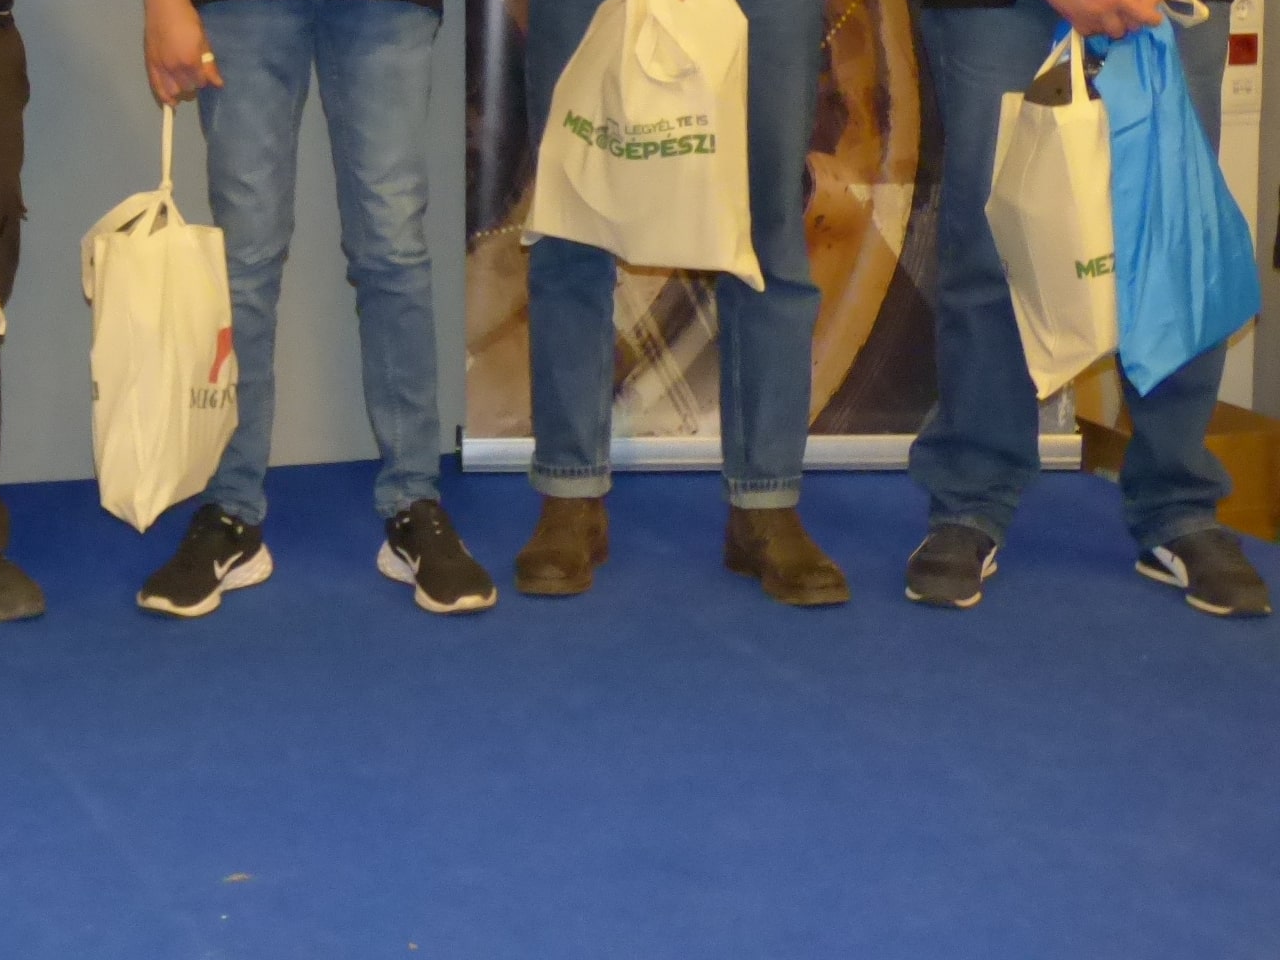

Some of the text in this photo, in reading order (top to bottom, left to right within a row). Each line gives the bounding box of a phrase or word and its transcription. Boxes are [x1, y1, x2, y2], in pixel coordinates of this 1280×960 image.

[624, 114, 709, 135] LEGYÉL TE IS
